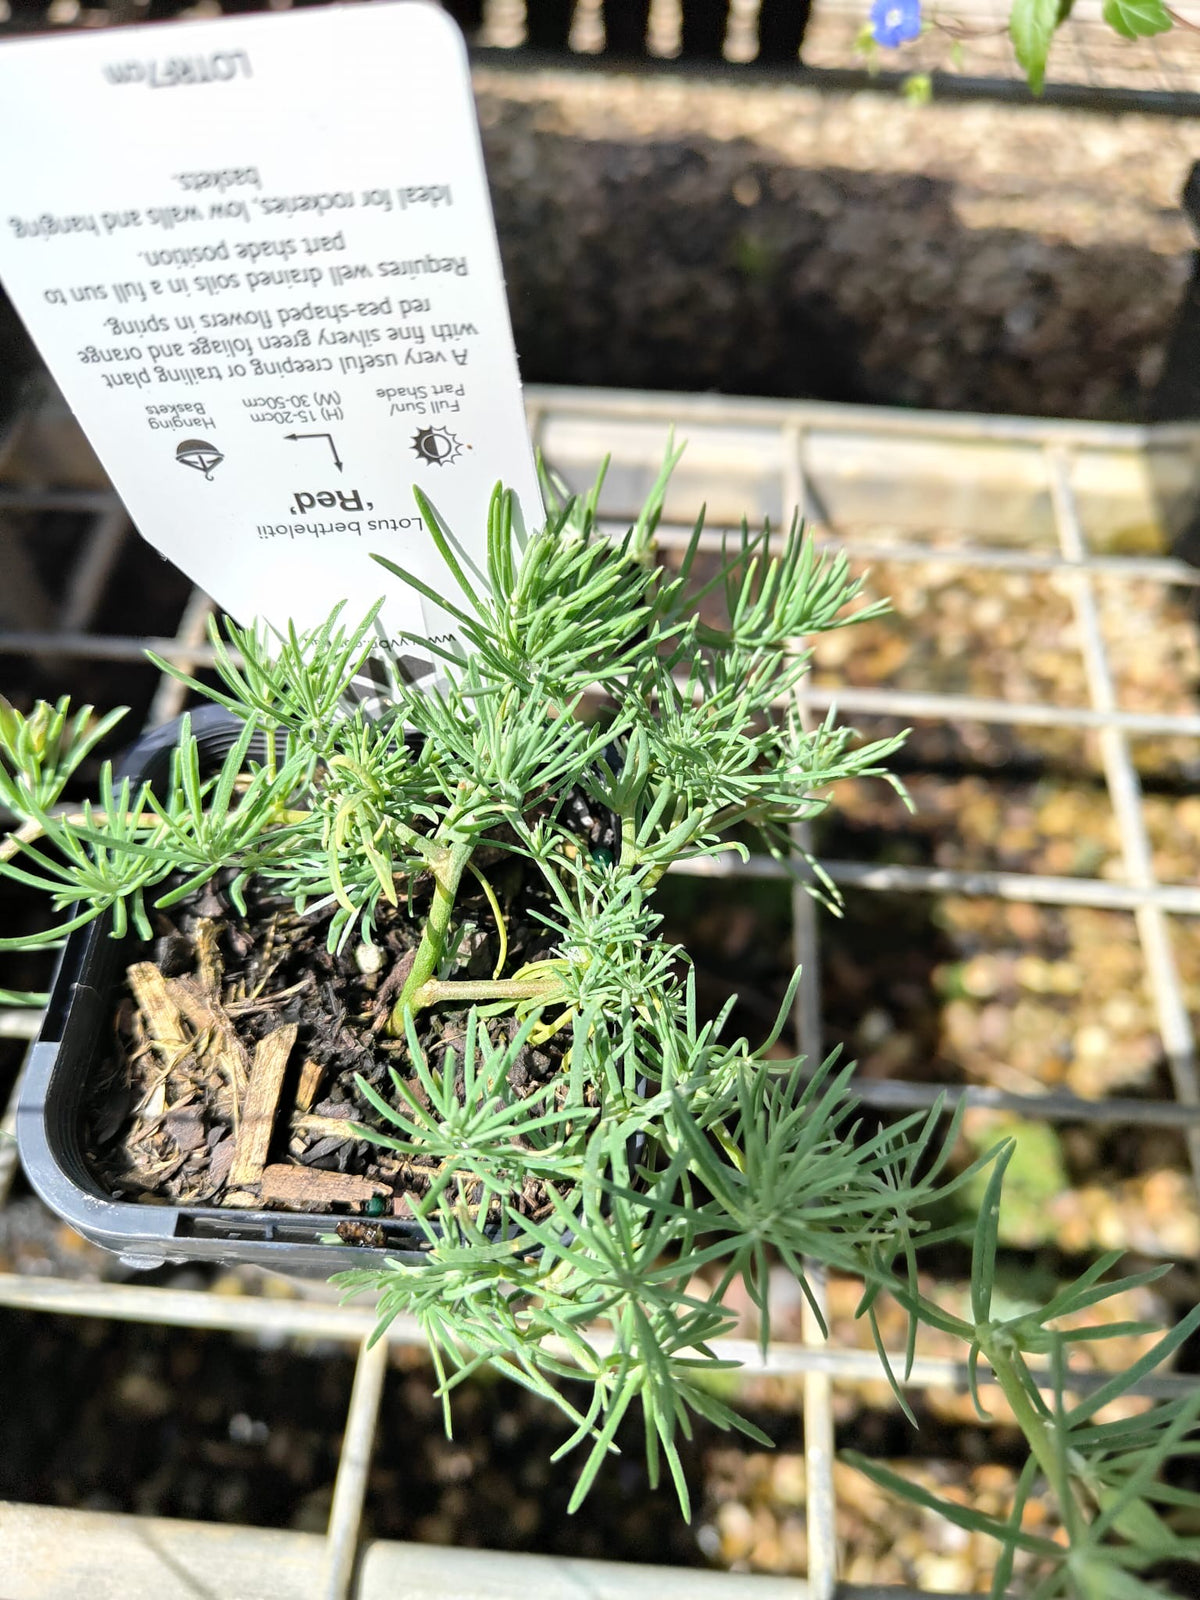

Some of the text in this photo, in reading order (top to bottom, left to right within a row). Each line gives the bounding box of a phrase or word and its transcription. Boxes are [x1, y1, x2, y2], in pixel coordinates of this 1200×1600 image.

[170, 166, 262, 193] baskets.
[8, 183, 453, 241] Ideal for rockeries, low walls and hanging
[137, 229, 346, 270] part shade position.
[43, 253, 469, 305] Requires well drained soils in a full sun to
[103, 296, 431, 339] red pea-shaped flowers in spring.
[77, 322, 479, 365] with fine silvery green foliage and orange
[101, 348, 468, 389] A very useful creeping or trailing plant
[242, 391, 341, 410] (W) 30-50cm
[376, 384, 465, 400] Part Shade
[145, 401, 206, 416] Baskets
[250, 407, 344, 424] (H) 15-20cm
[389, 400, 461, 416] Full Sun/
[147, 415, 217, 431] Hanging
[256, 517, 423, 539] Lotus berthelotii
